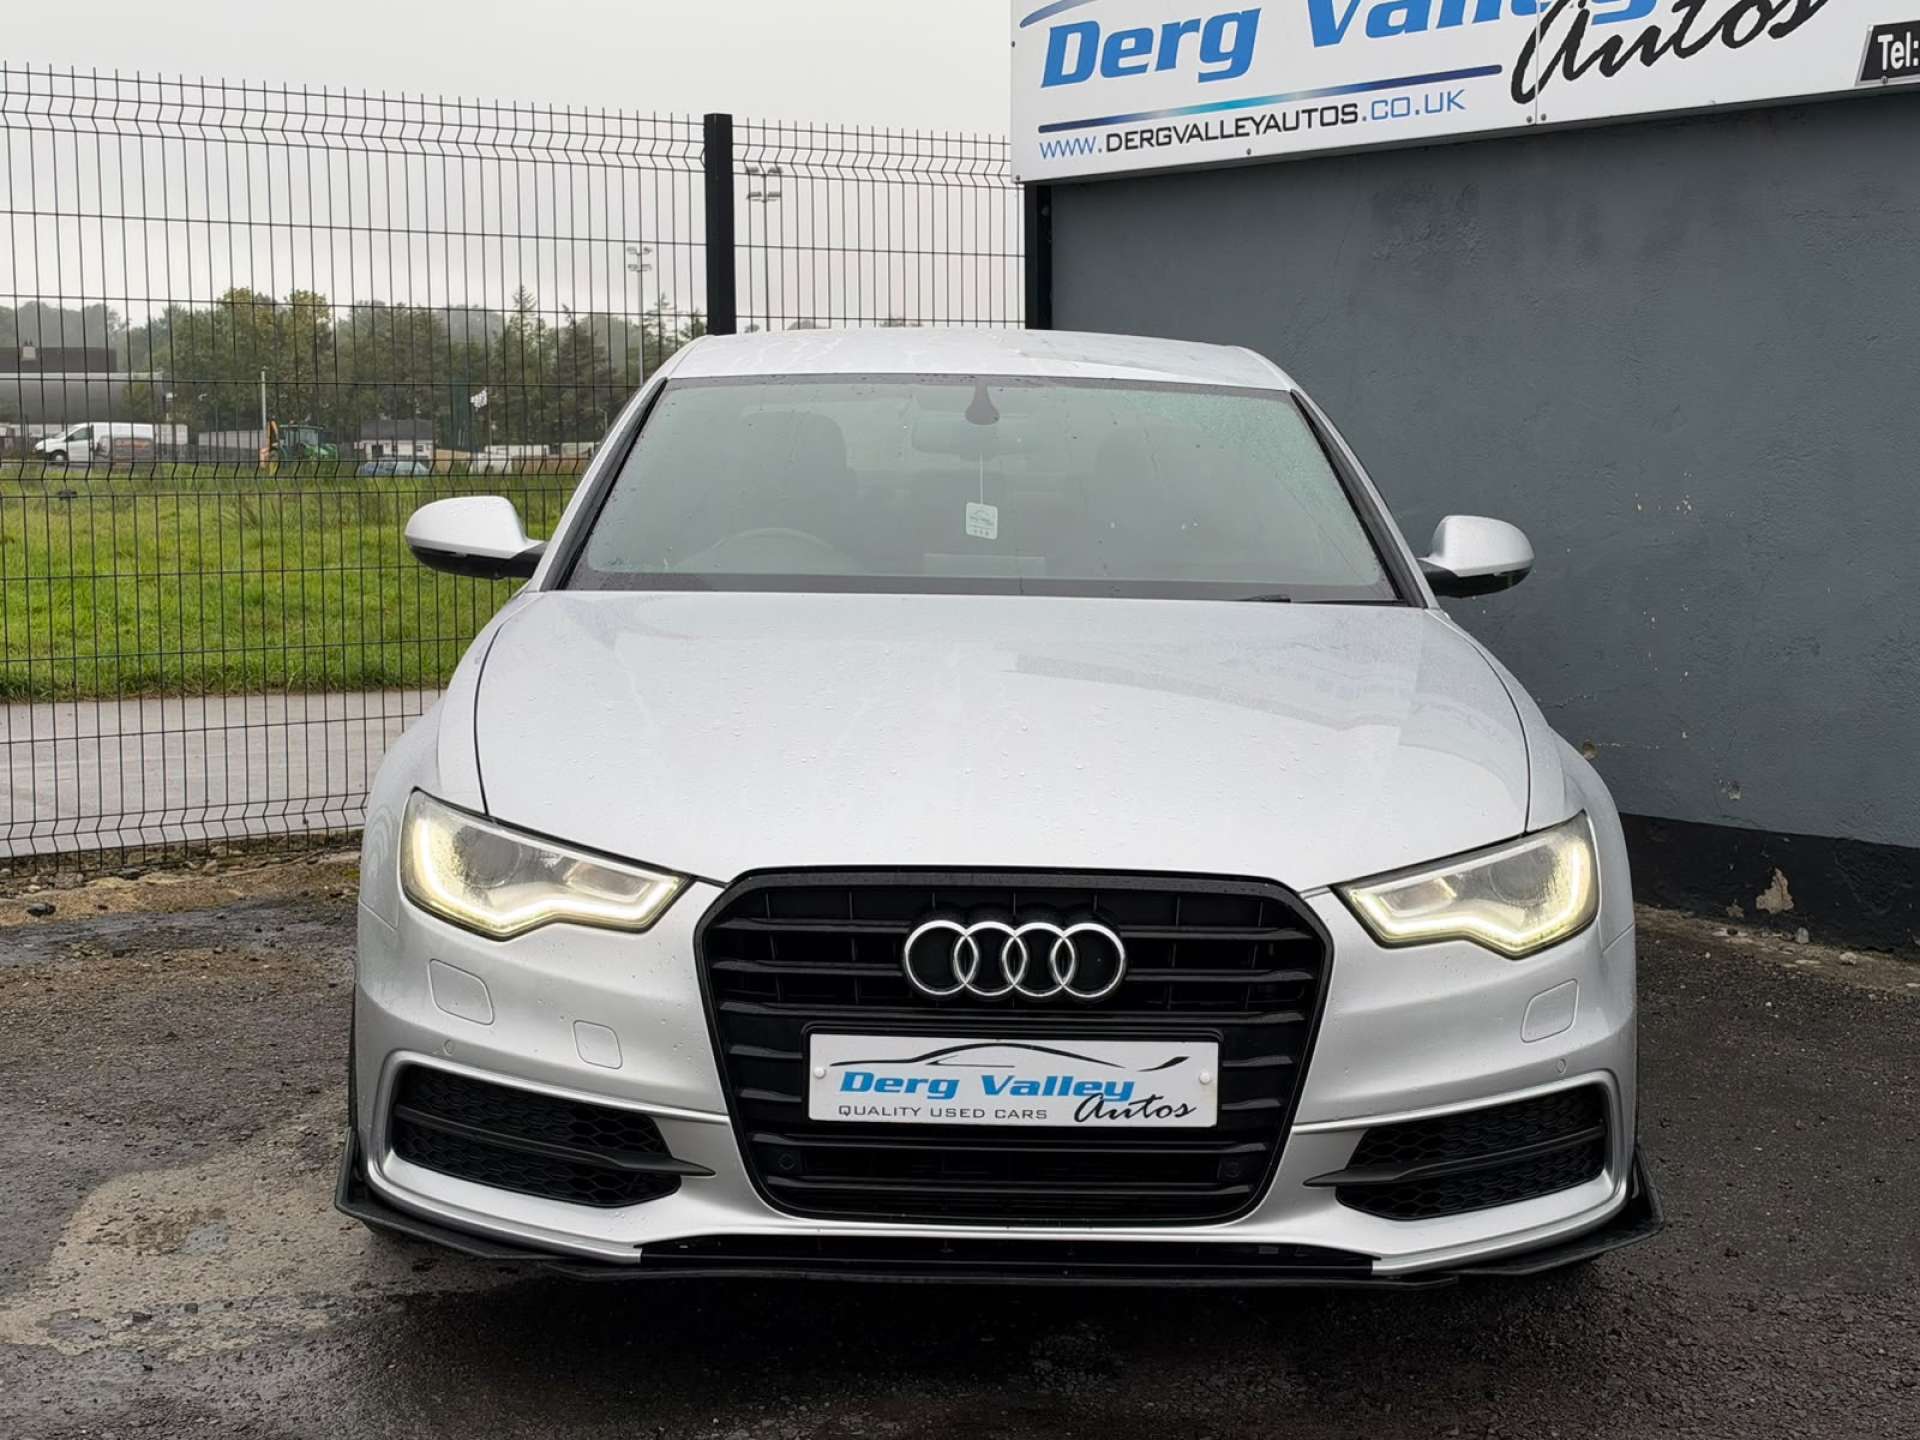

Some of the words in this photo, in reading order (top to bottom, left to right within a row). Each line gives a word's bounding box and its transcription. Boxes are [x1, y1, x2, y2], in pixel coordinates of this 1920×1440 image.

[1041, 8, 1261, 88] Derg
[1877, 31, 1919, 70] Tel:
[840, 1071, 960, 1100] Derg
[981, 1075, 1135, 1102] Valley
[838, 1105, 921, 1118] QUALITY
[929, 1107, 986, 1119] USED
[994, 1108, 1048, 1120] CARS
[1073, 1092, 1197, 1123] Autos
